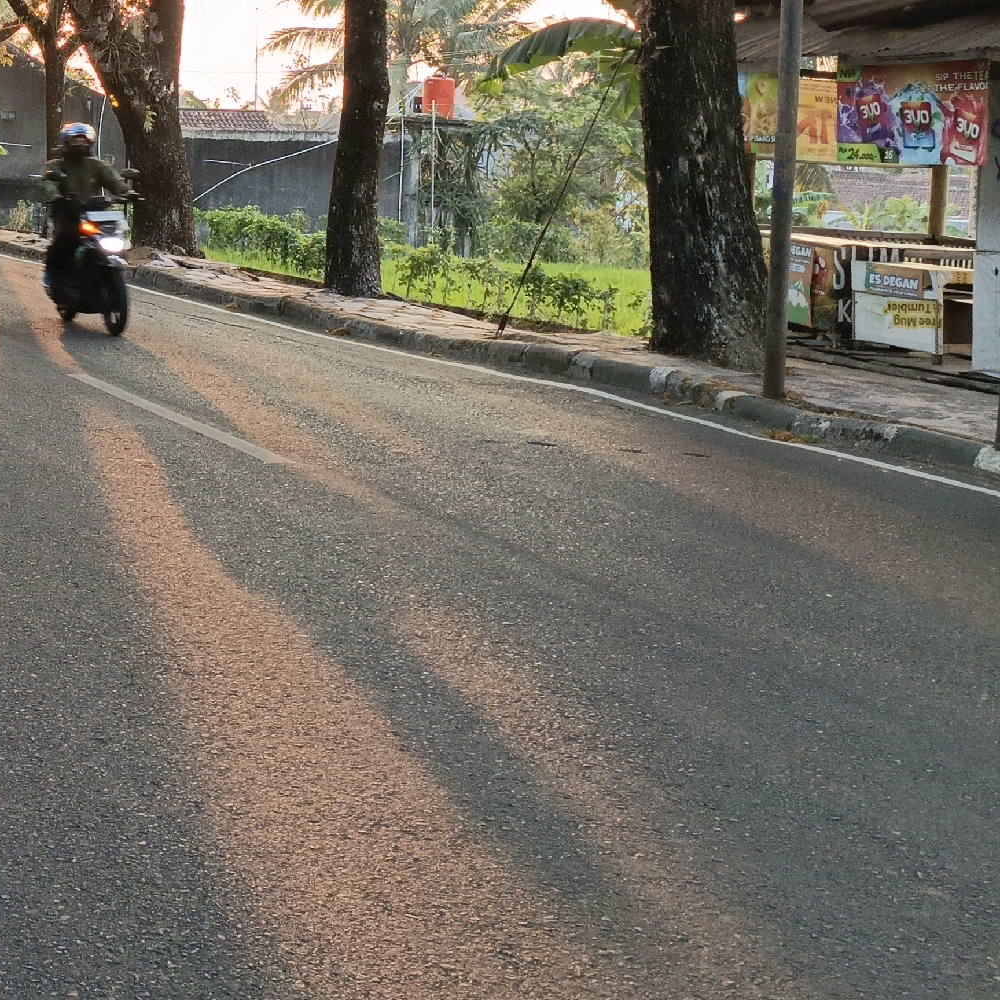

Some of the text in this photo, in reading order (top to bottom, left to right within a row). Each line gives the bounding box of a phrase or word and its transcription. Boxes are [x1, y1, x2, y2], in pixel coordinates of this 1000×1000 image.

[935, 73, 950, 82] SIP
[953, 71, 973, 80] THE
[934, 83, 956, 92] THE
[884, 150, 893, 160] 16
[869, 273, 919, 290] ES DEGAN
[893, 314, 917, 327] Mug
